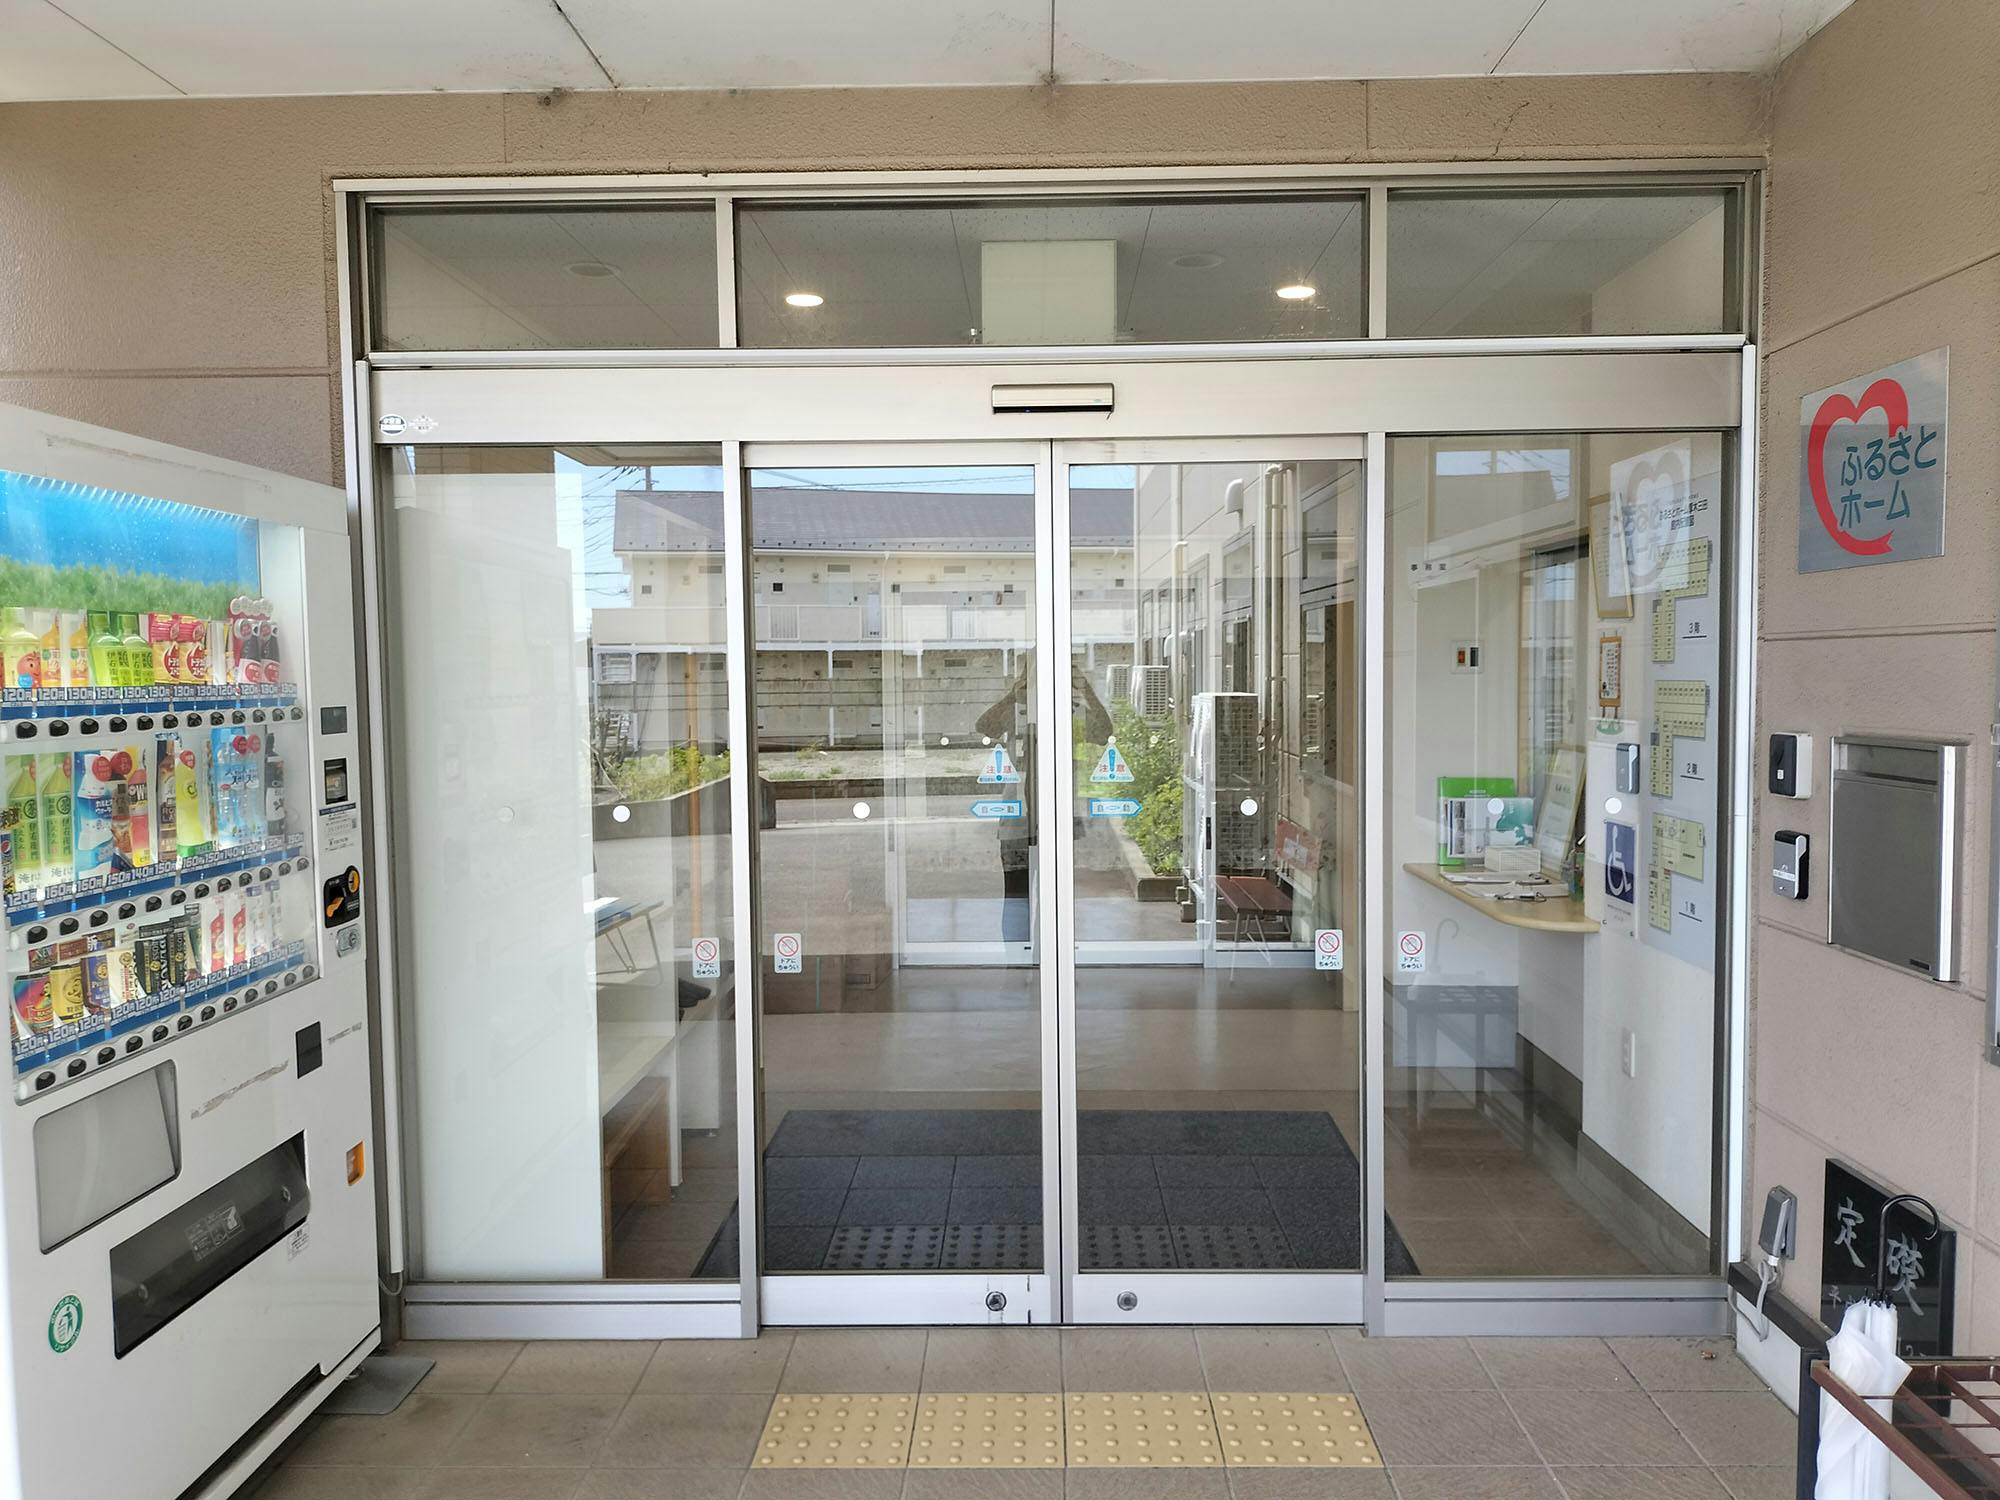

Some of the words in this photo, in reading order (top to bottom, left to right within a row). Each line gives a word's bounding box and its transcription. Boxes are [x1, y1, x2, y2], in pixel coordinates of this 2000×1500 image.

[1840, 425, 1938, 487] ふるさと
[1839, 480, 1911, 529] ホーム
[1834, 1196, 1925, 1316] 定礎
